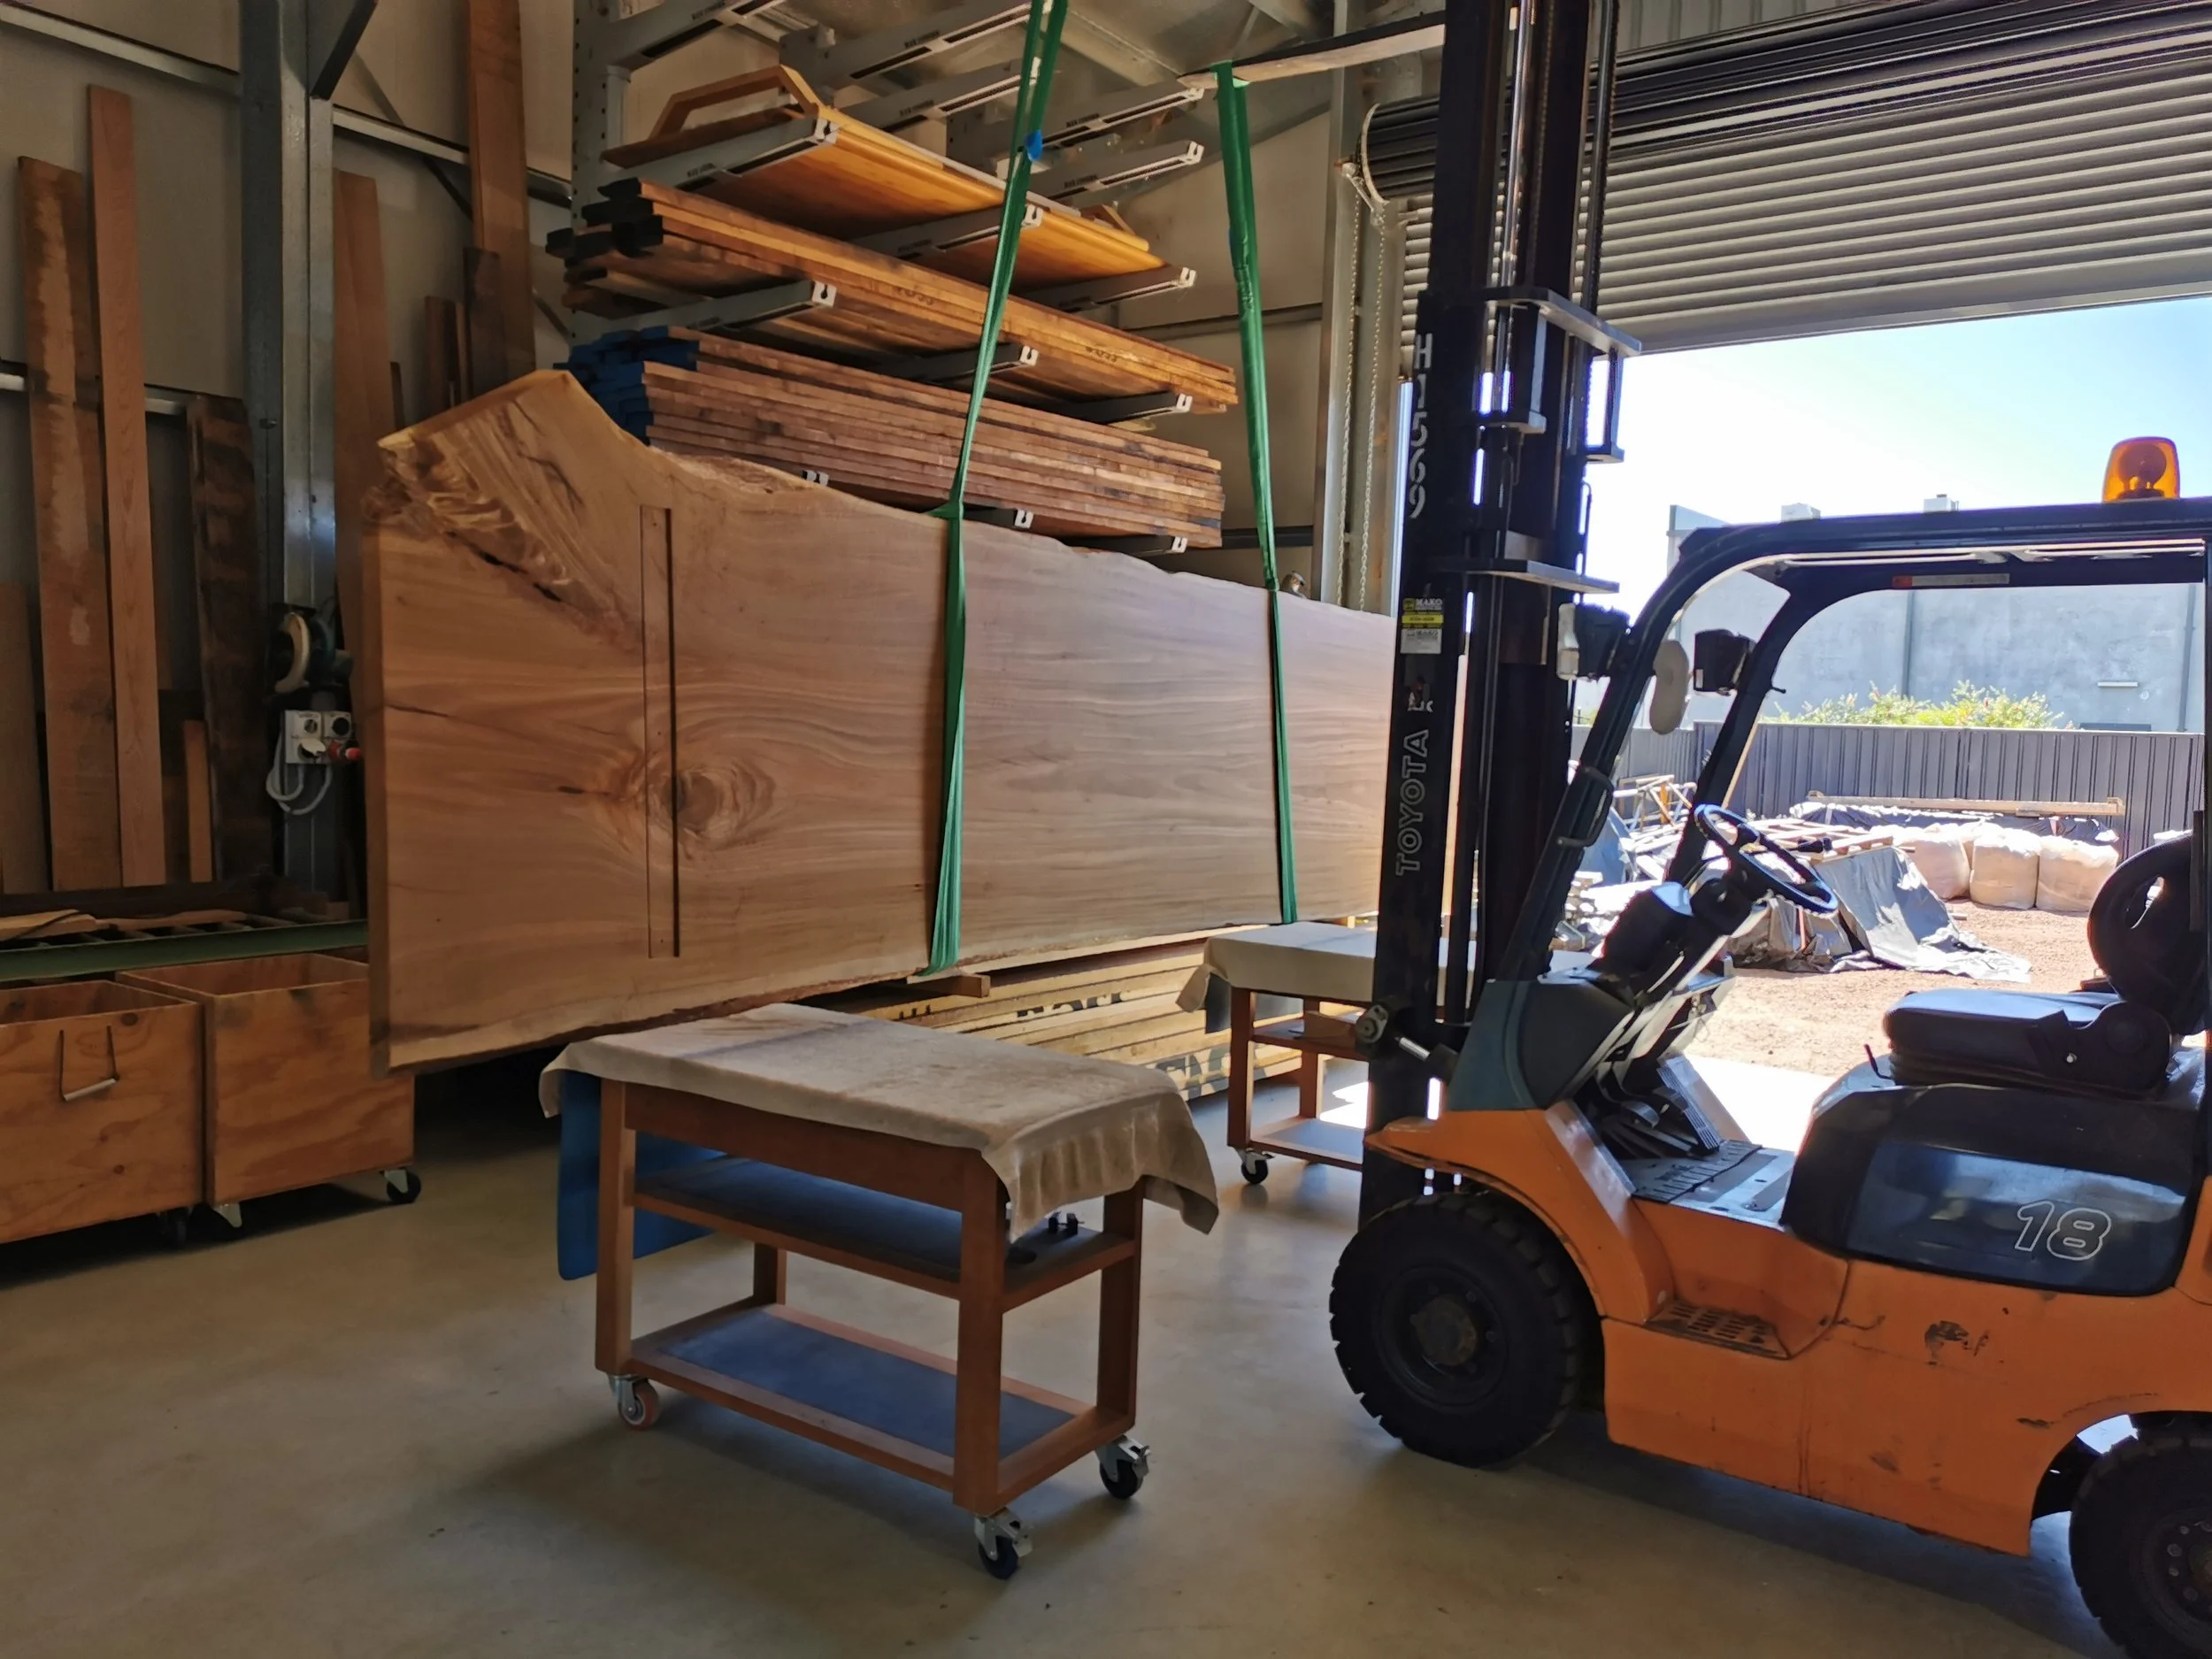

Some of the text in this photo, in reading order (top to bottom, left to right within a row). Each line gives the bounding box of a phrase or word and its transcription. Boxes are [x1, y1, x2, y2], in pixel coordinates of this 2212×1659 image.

[1409, 333, 1433, 519] H1569
[1395, 728, 1430, 876] TOYOTA
[2014, 1199, 2113, 1262] 18
